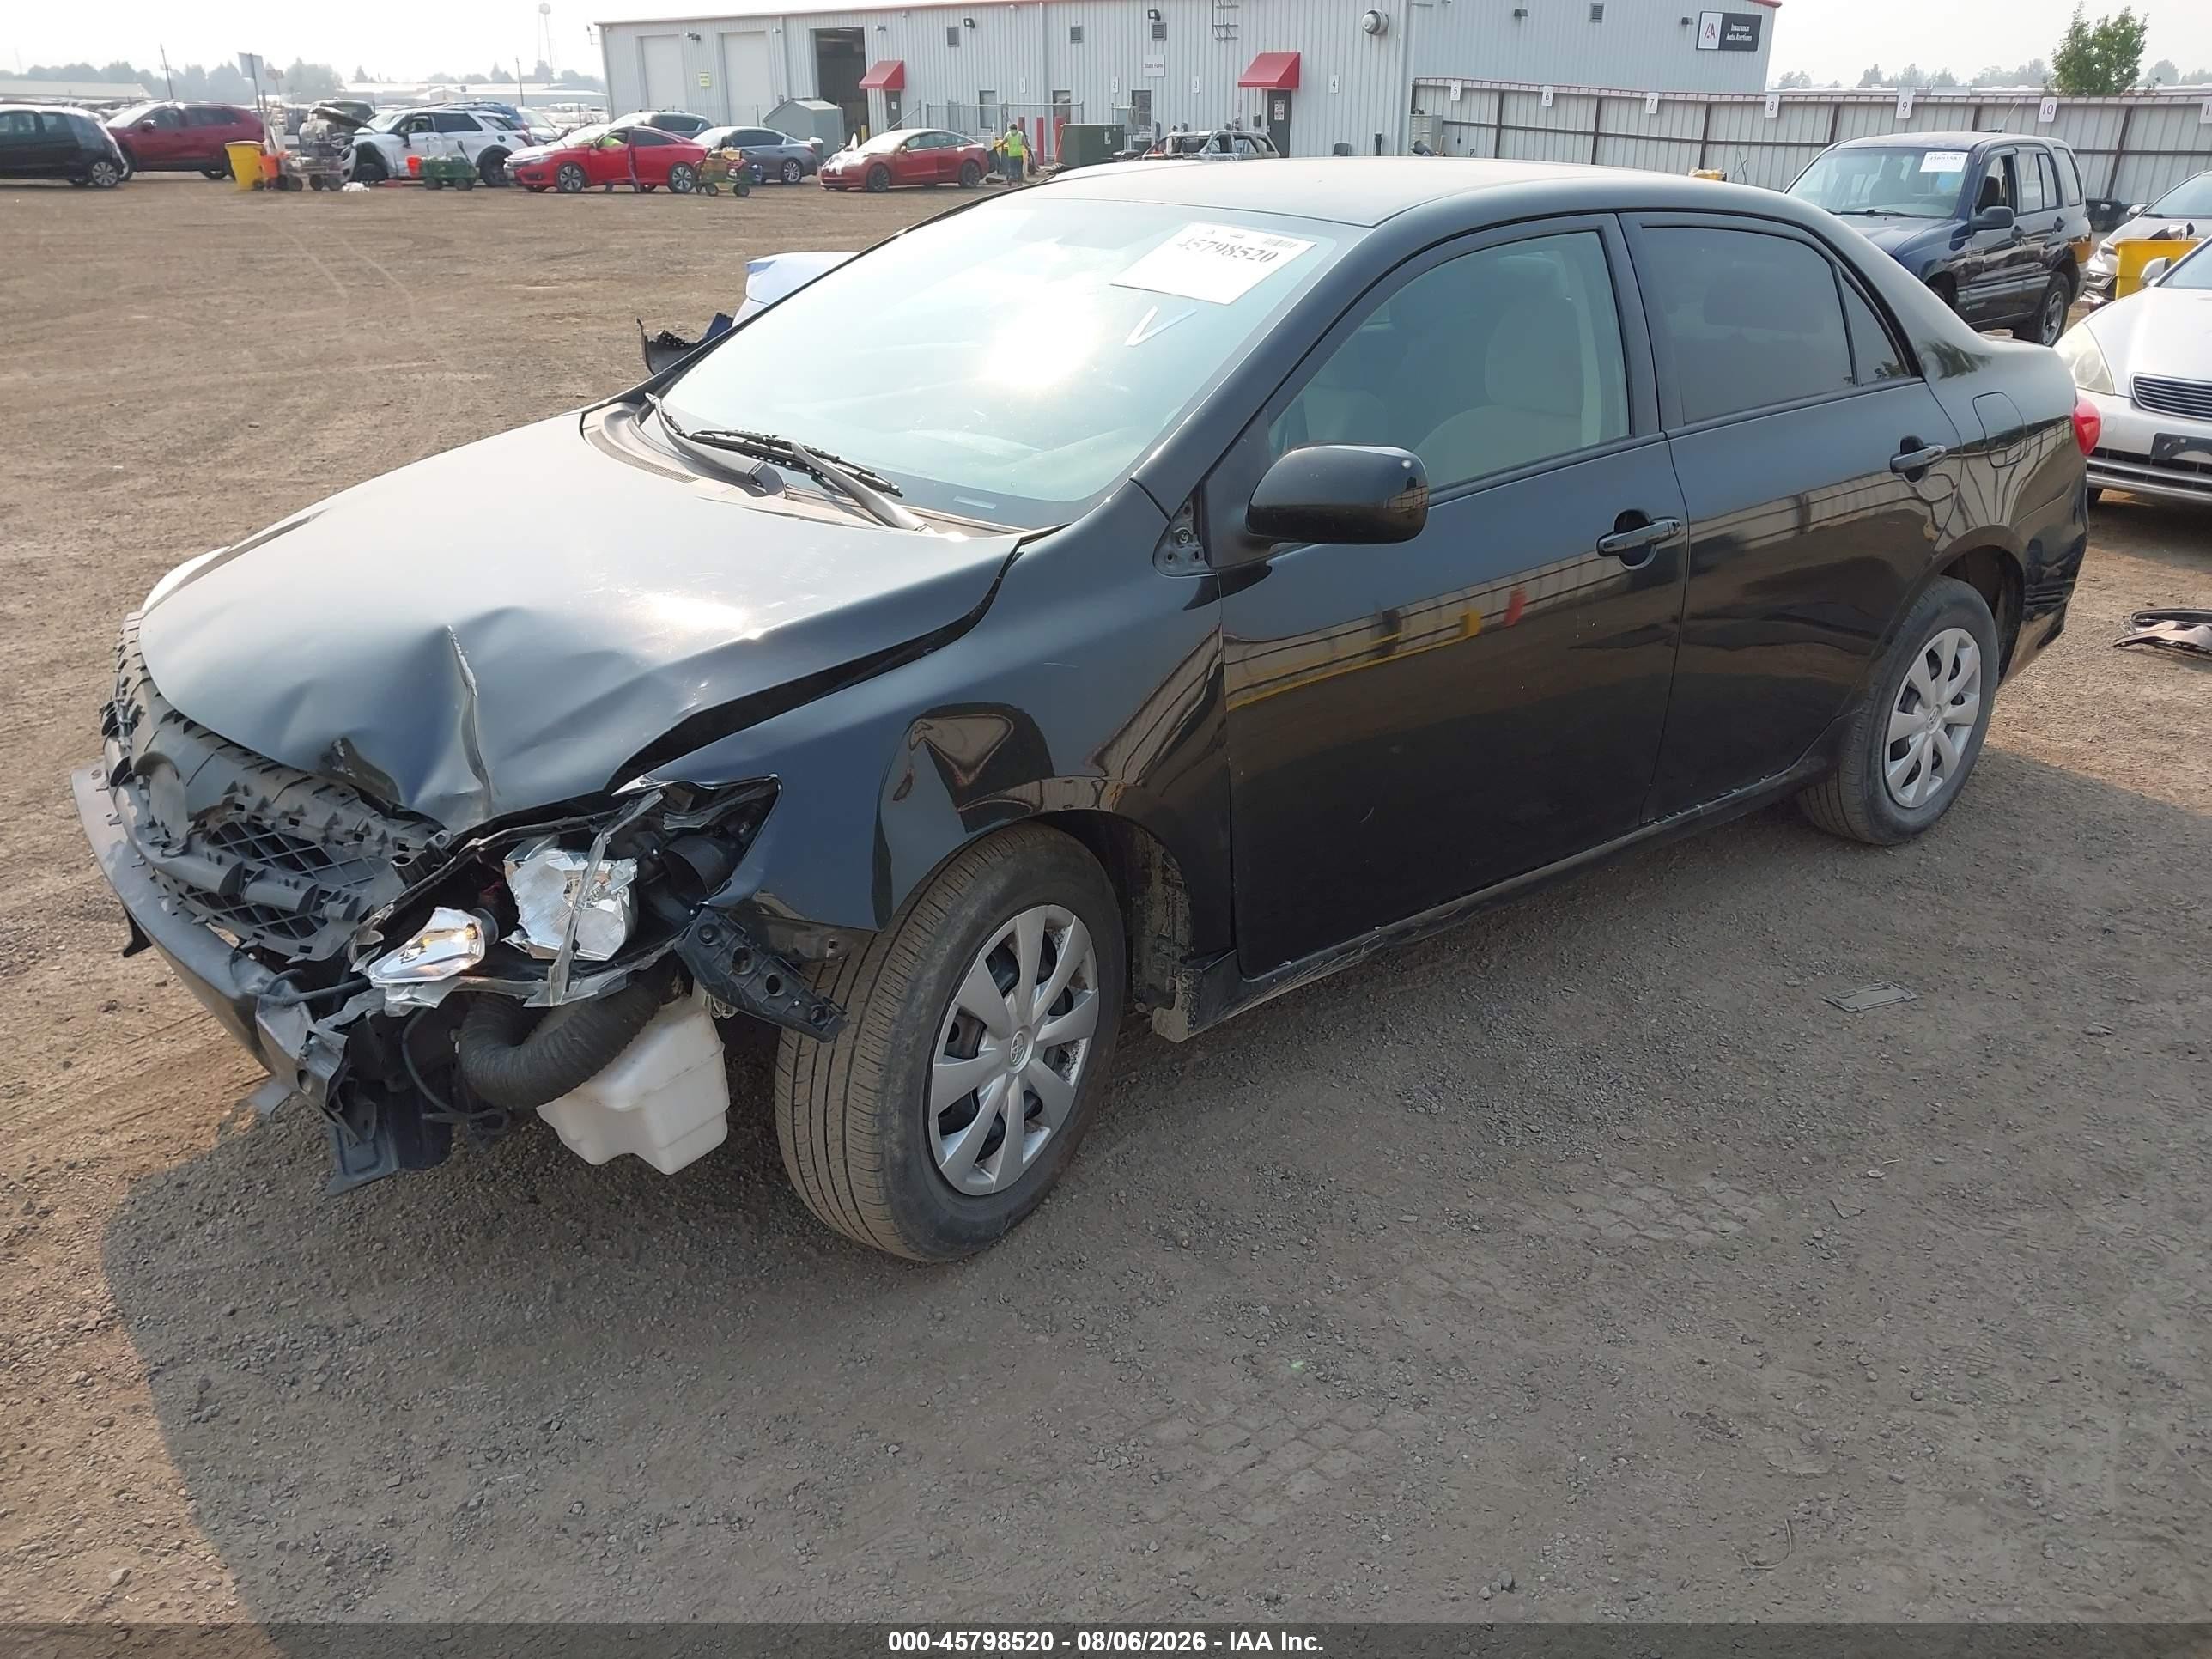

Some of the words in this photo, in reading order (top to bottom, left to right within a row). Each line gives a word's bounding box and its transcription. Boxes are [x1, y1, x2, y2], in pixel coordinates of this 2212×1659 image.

[1730, 22, 1750, 32] Insurance
[1726, 33, 1735, 41] Auto
[1545, 92, 1550, 100] 6
[1650, 98, 1655, 108] 7
[1769, 101, 1774, 111] 8
[1902, 101, 1908, 112] 9
[2042, 104, 2054, 115] 10
